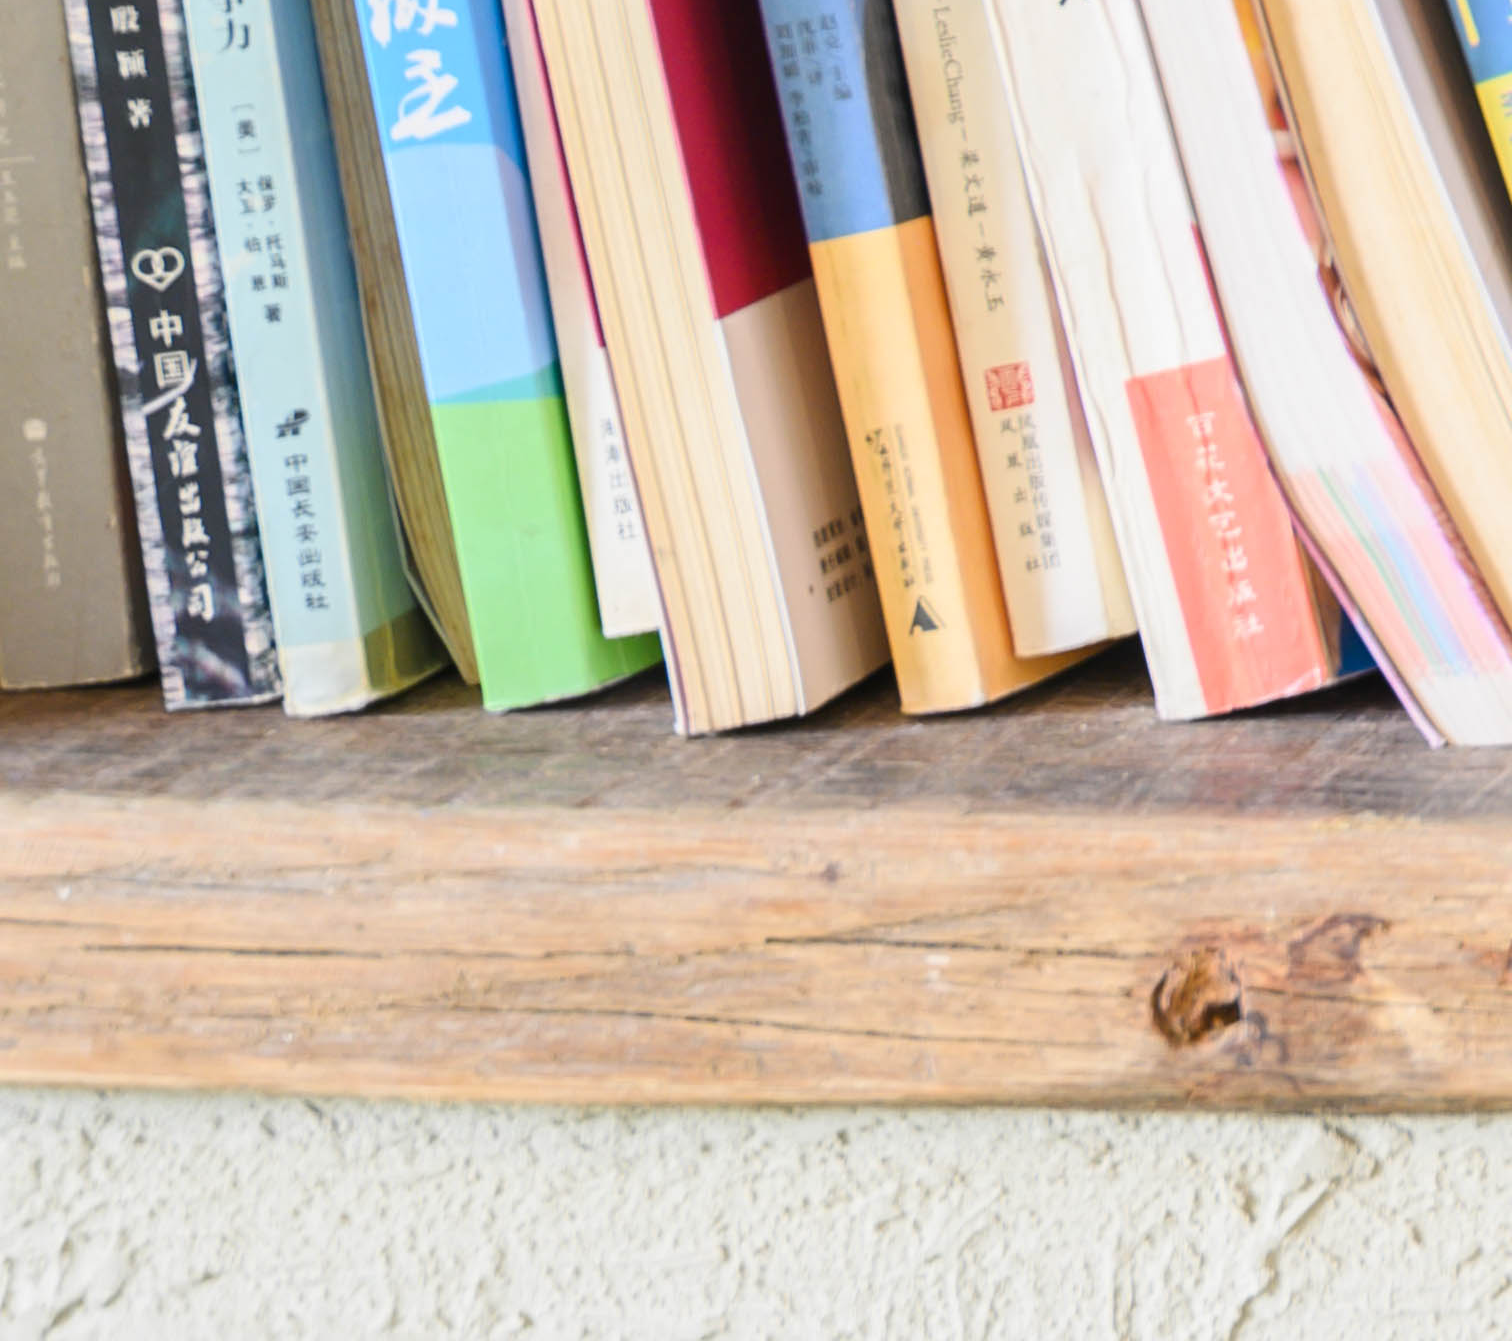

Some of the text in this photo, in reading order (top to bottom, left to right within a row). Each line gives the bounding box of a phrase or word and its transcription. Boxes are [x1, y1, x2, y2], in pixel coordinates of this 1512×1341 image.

[148, 309, 216, 623] 中国友谊出版公司
